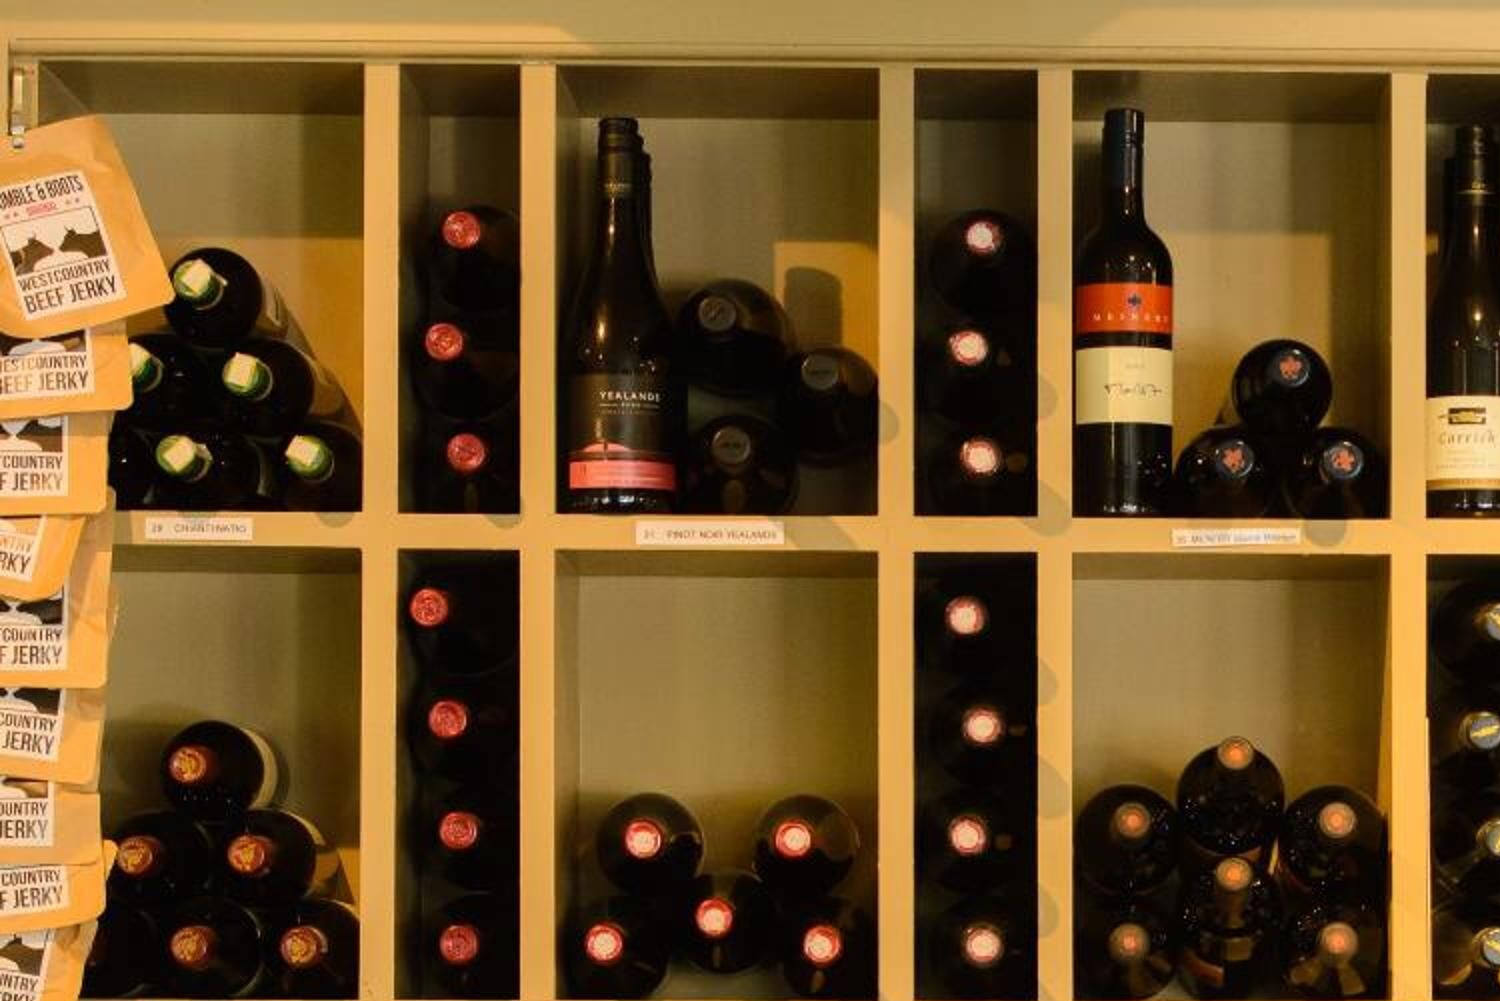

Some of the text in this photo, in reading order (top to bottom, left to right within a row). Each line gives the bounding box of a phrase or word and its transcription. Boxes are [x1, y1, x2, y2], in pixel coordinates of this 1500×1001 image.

[46, 175, 84, 199] BOOTS
[18, 258, 111, 292] WESTCOUNTRY
[24, 275, 117, 314] BEEF JERKY
[0, 355, 87, 373] ESTCOUNTRY
[40, 370, 88, 391] JERKY
[12, 472, 63, 491] JERKY
[11, 646, 63, 666] JERKY
[2, 731, 55, 755] JERKY
[13, 885, 63, 909] JERKY
